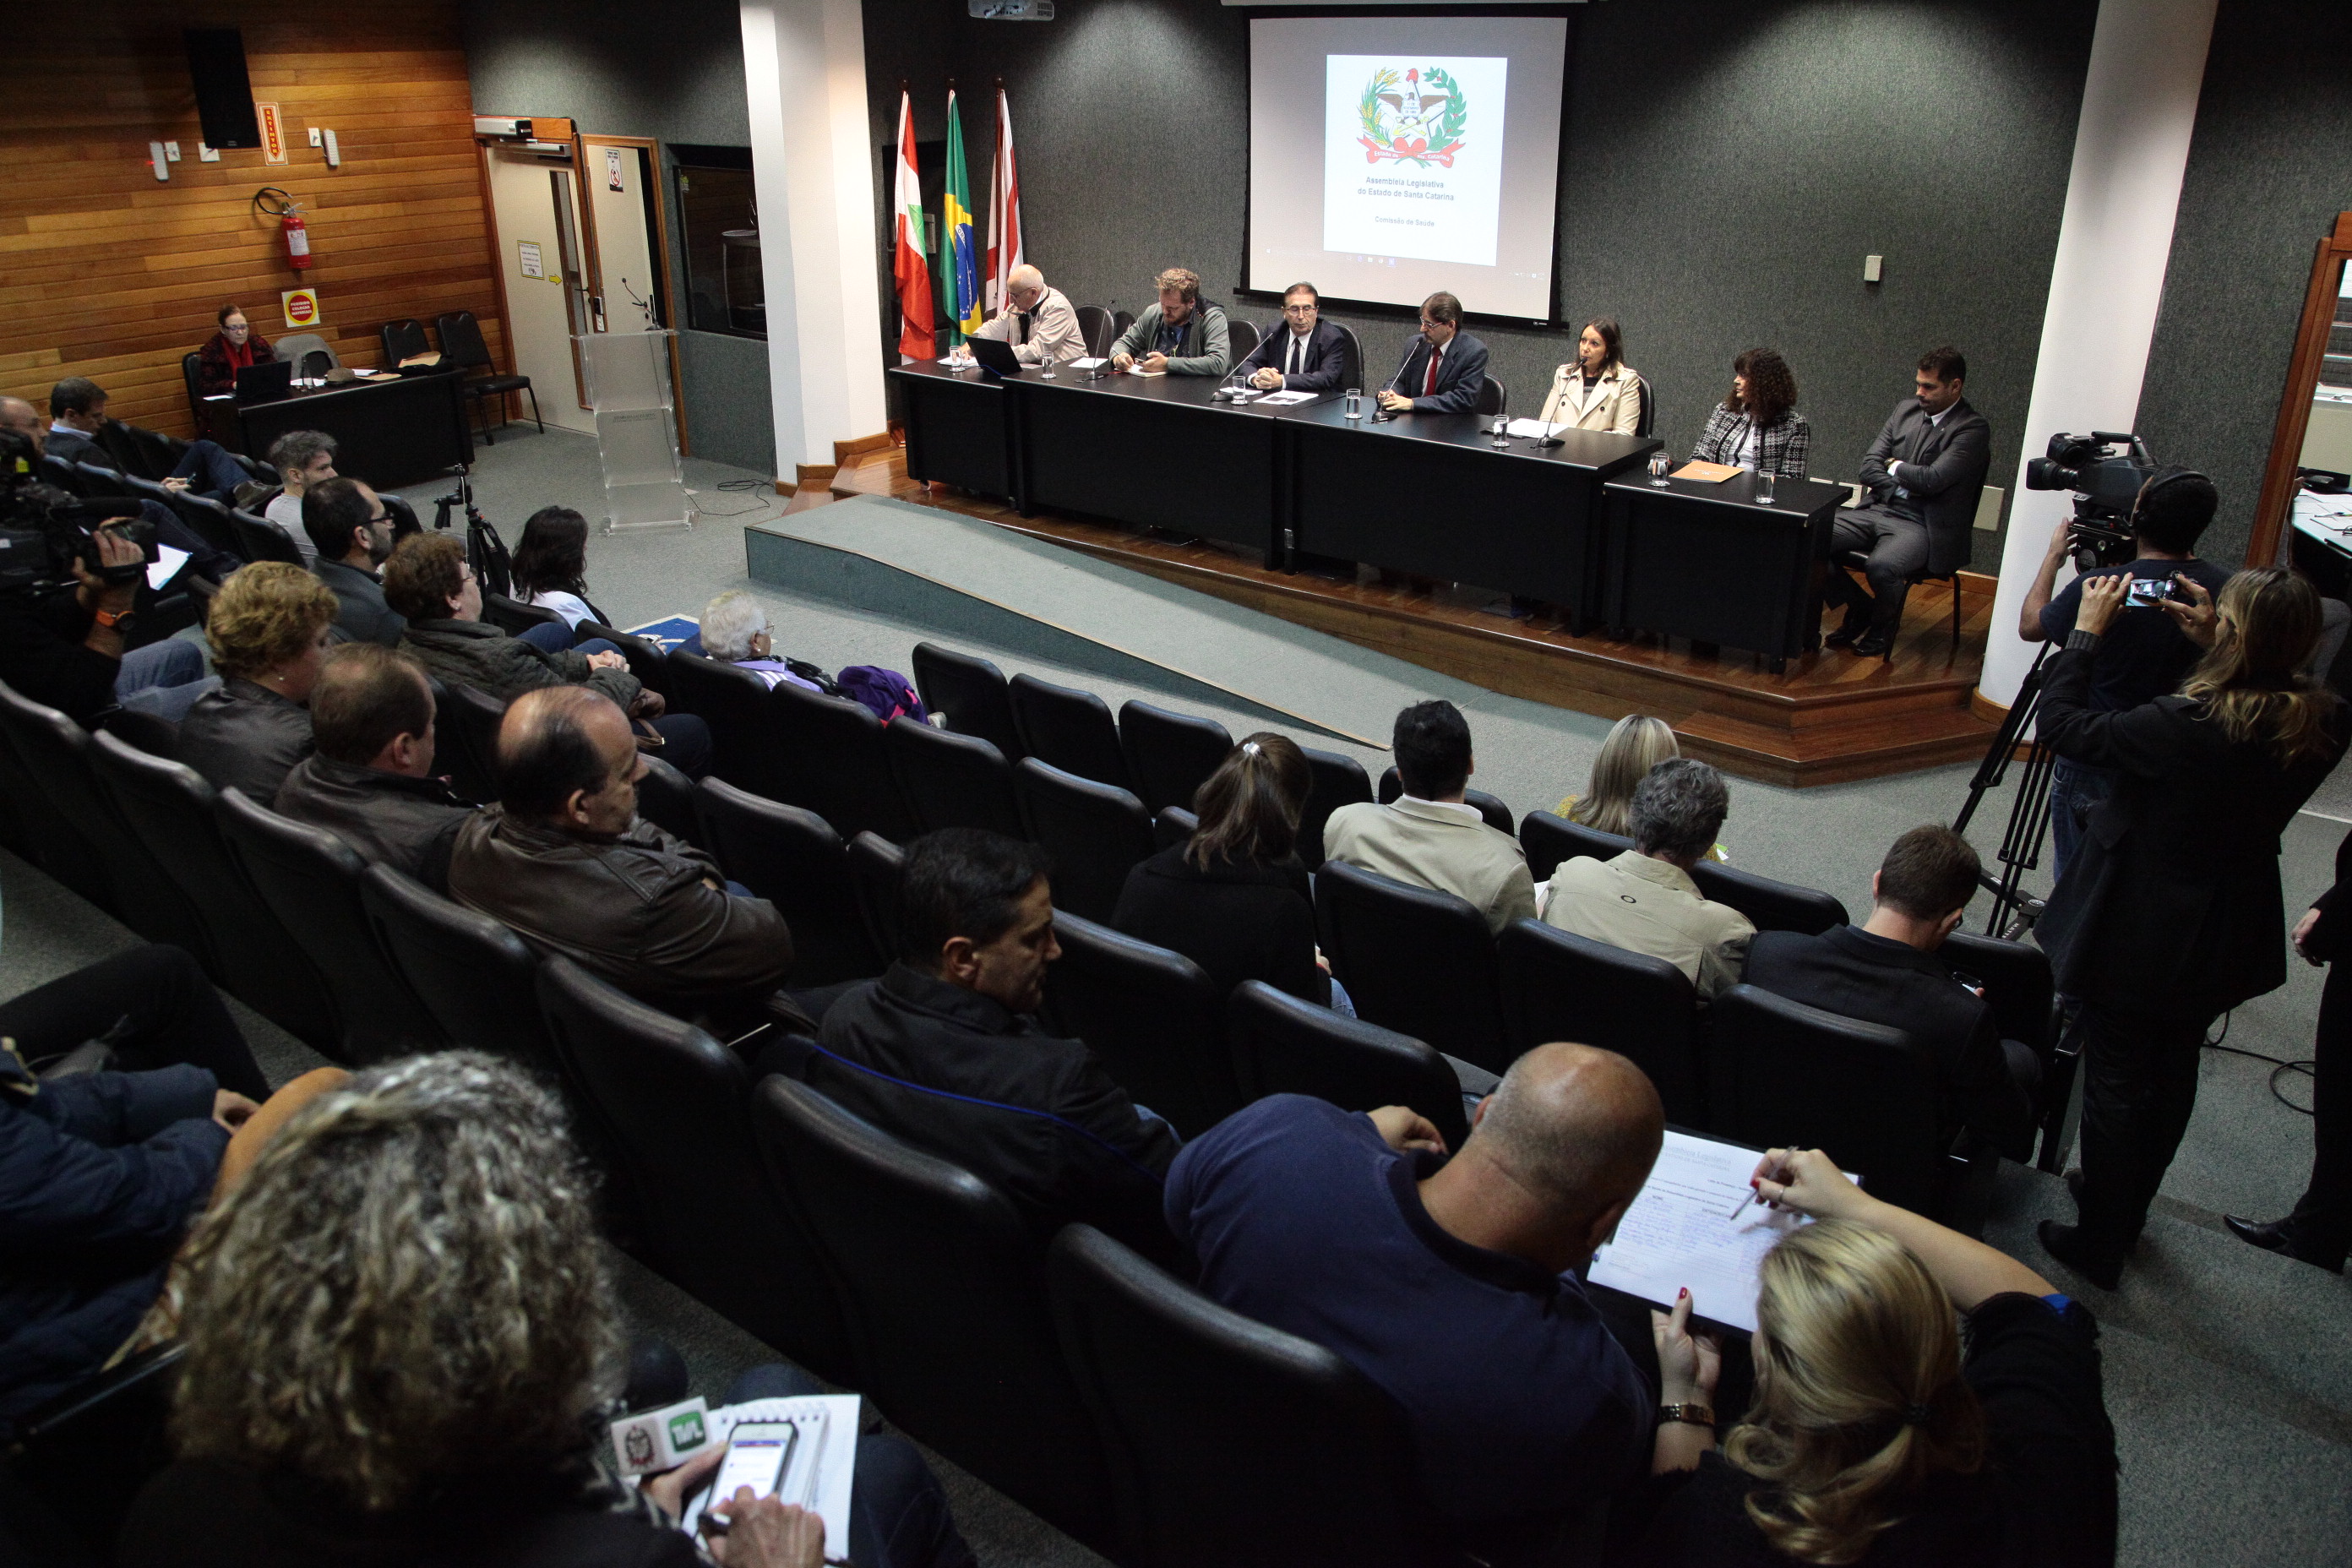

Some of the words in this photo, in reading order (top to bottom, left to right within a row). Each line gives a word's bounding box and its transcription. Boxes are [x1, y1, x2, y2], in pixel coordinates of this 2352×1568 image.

[266, 110, 278, 154] EXTINTOR
[1366, 177, 1404, 186] Assembleia
[1407, 179, 1444, 188] Legislativa
[1368, 188, 1392, 196] Estado
[1403, 190, 1424, 199] Santa
[1424, 192, 1454, 201] Catarina
[1375, 215, 1404, 225] Comissão
